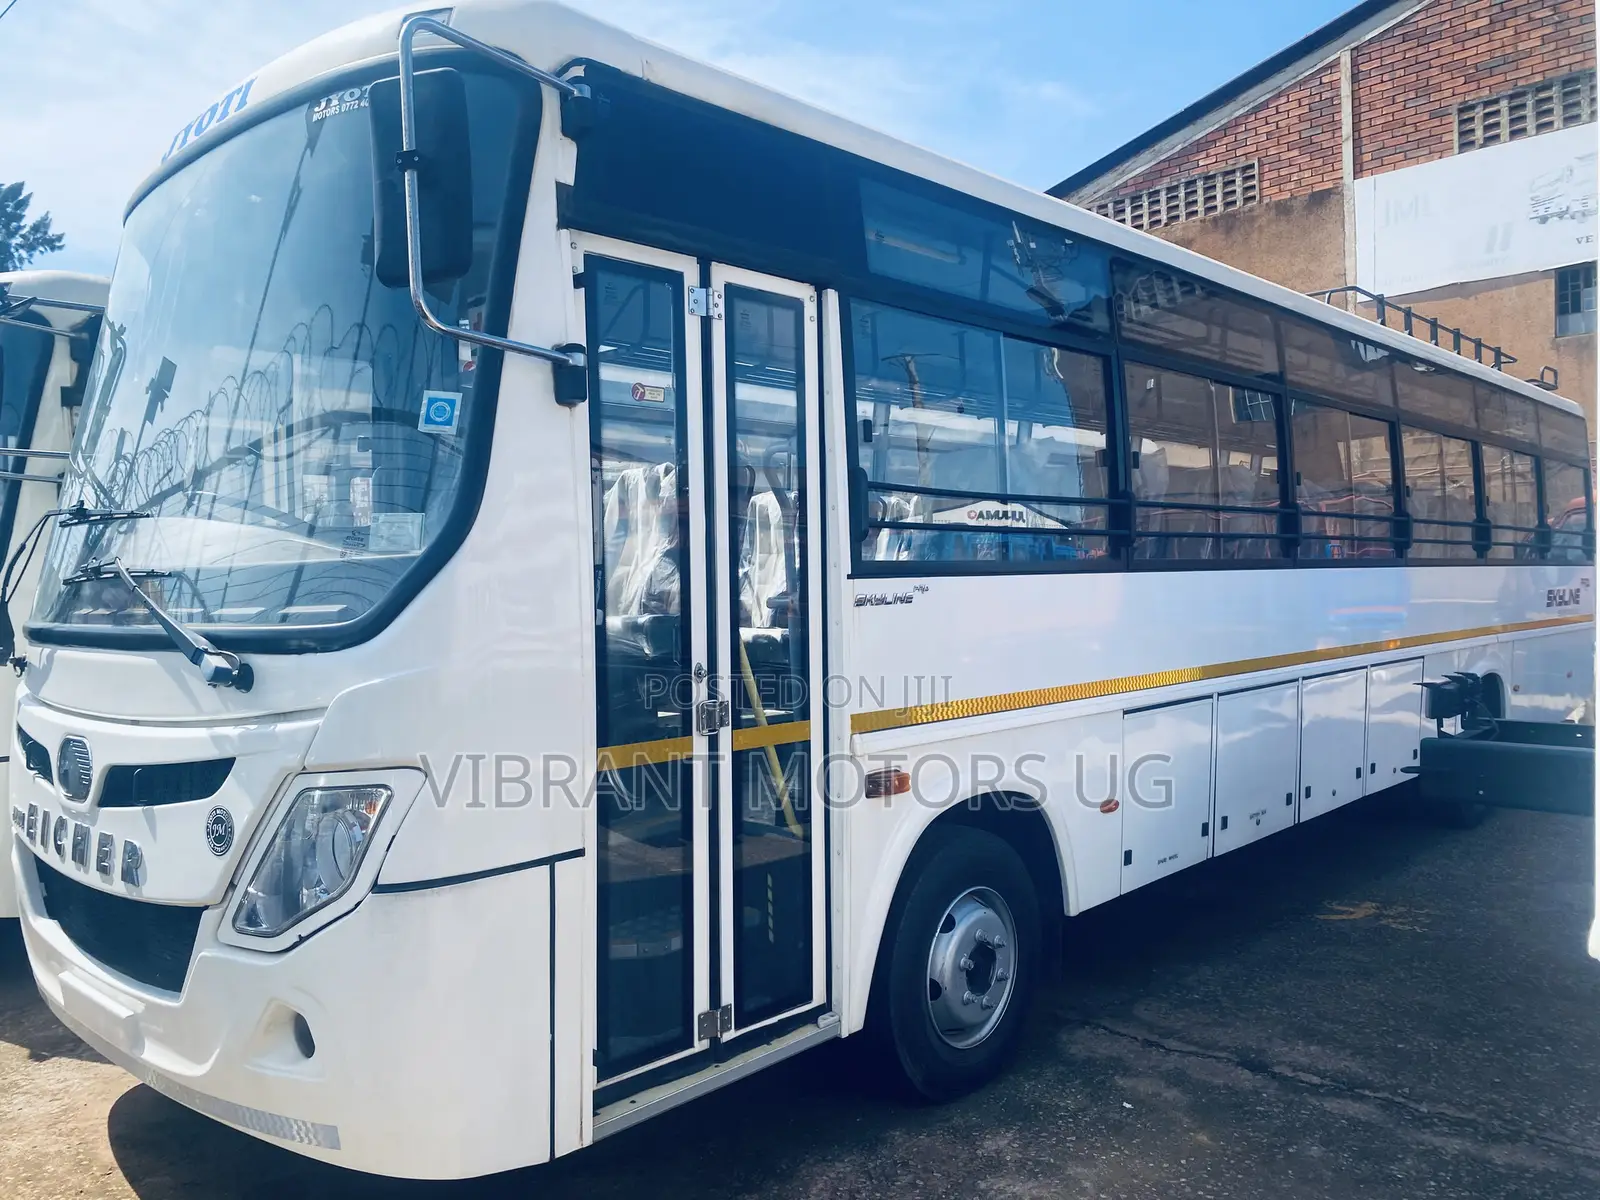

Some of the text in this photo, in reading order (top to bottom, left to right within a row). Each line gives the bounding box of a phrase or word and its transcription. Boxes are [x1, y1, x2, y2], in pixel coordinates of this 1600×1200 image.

[161, 75, 258, 165] JYOTI
[312, 105, 340, 122] MOTORS
[341, 100, 359, 112] 0772
[854, 592, 914, 607] SKYLINE
[212, 823, 227, 838] JM
[26, 802, 143, 888] EICHER
